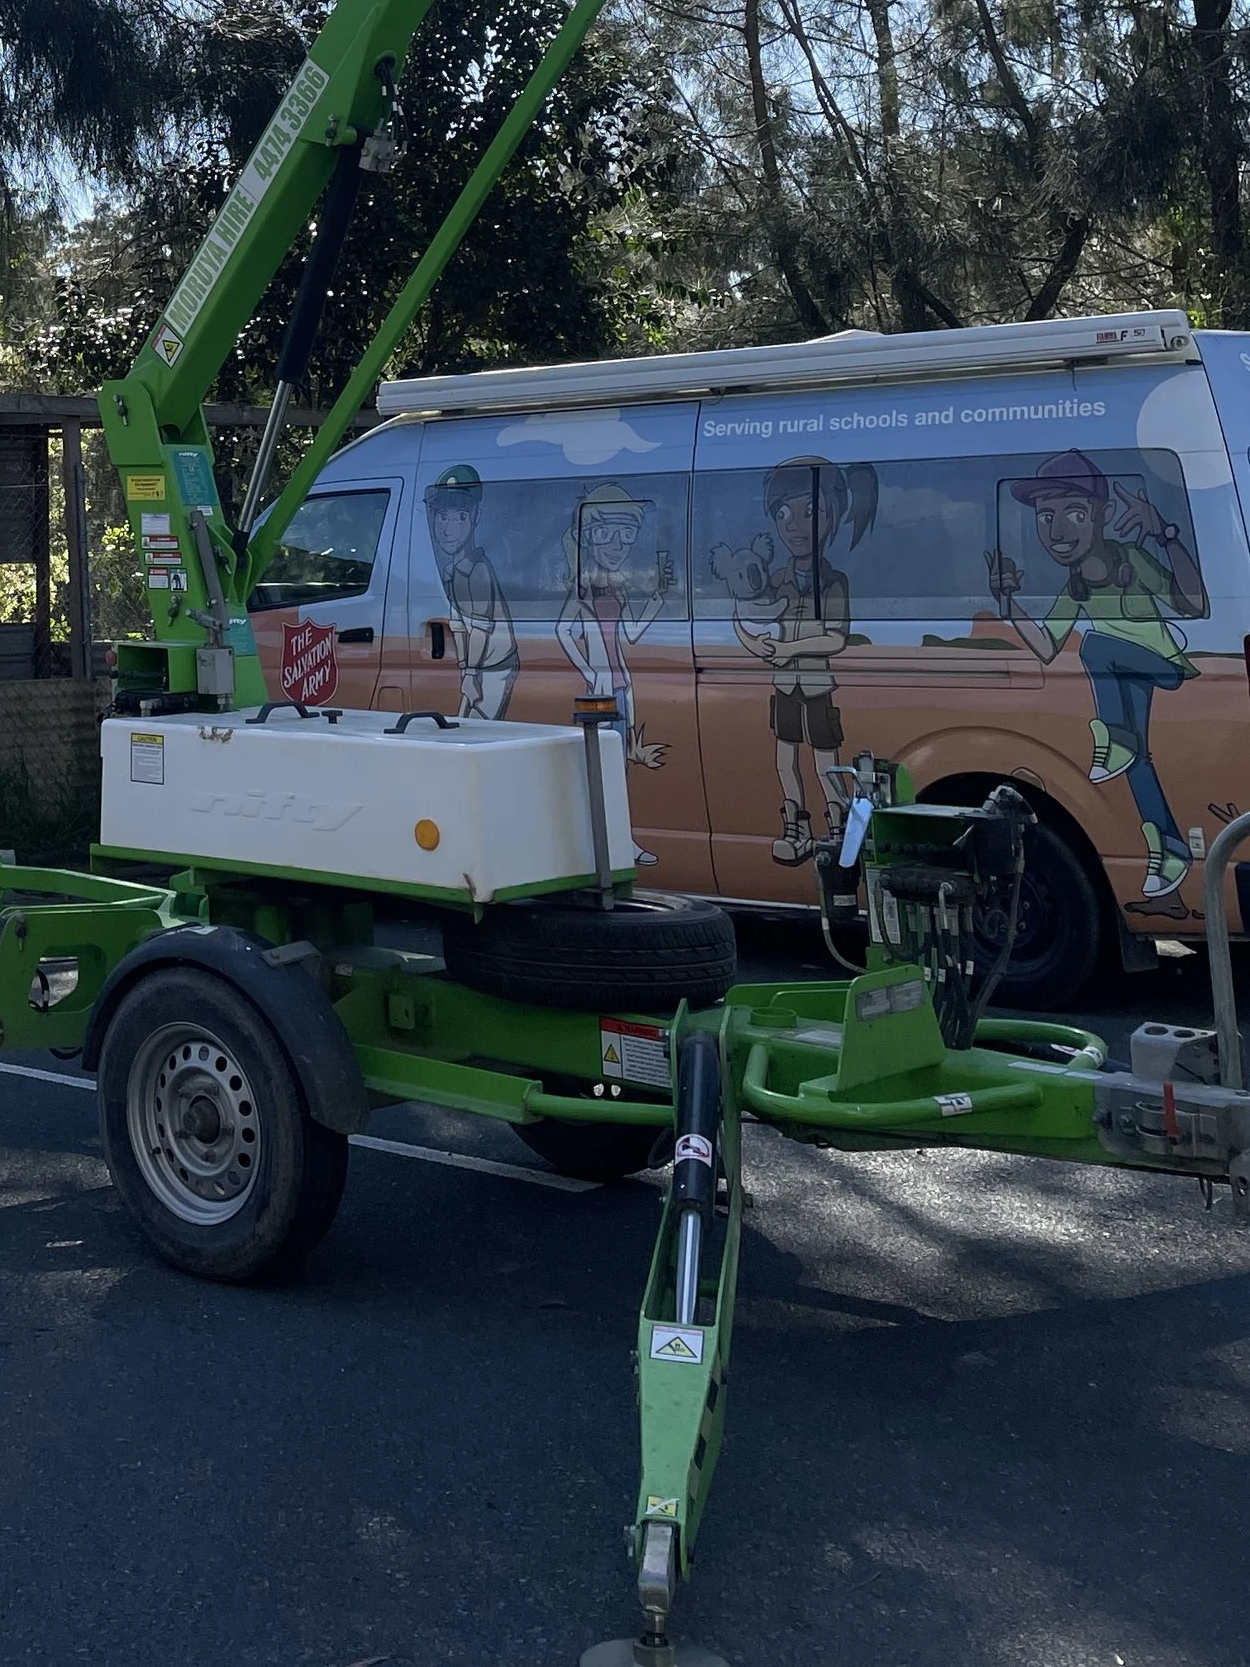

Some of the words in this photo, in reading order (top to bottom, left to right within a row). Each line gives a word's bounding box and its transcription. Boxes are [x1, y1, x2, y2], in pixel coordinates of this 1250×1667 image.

[168, 244, 228, 332] MORUYA
[215, 188, 255, 247] HIRE
[253, 123, 291, 182] 4474
[280, 65, 325, 131] 3366
[703, 420, 773, 439] Serving
[778, 415, 824, 433] rural
[829, 409, 908, 430] schools
[914, 404, 954, 426] and
[960, 398, 1106, 423] communities
[283, 632, 332, 688] SALVATION
[291, 627, 312, 656] THE
[301, 660, 331, 702] ARMY
